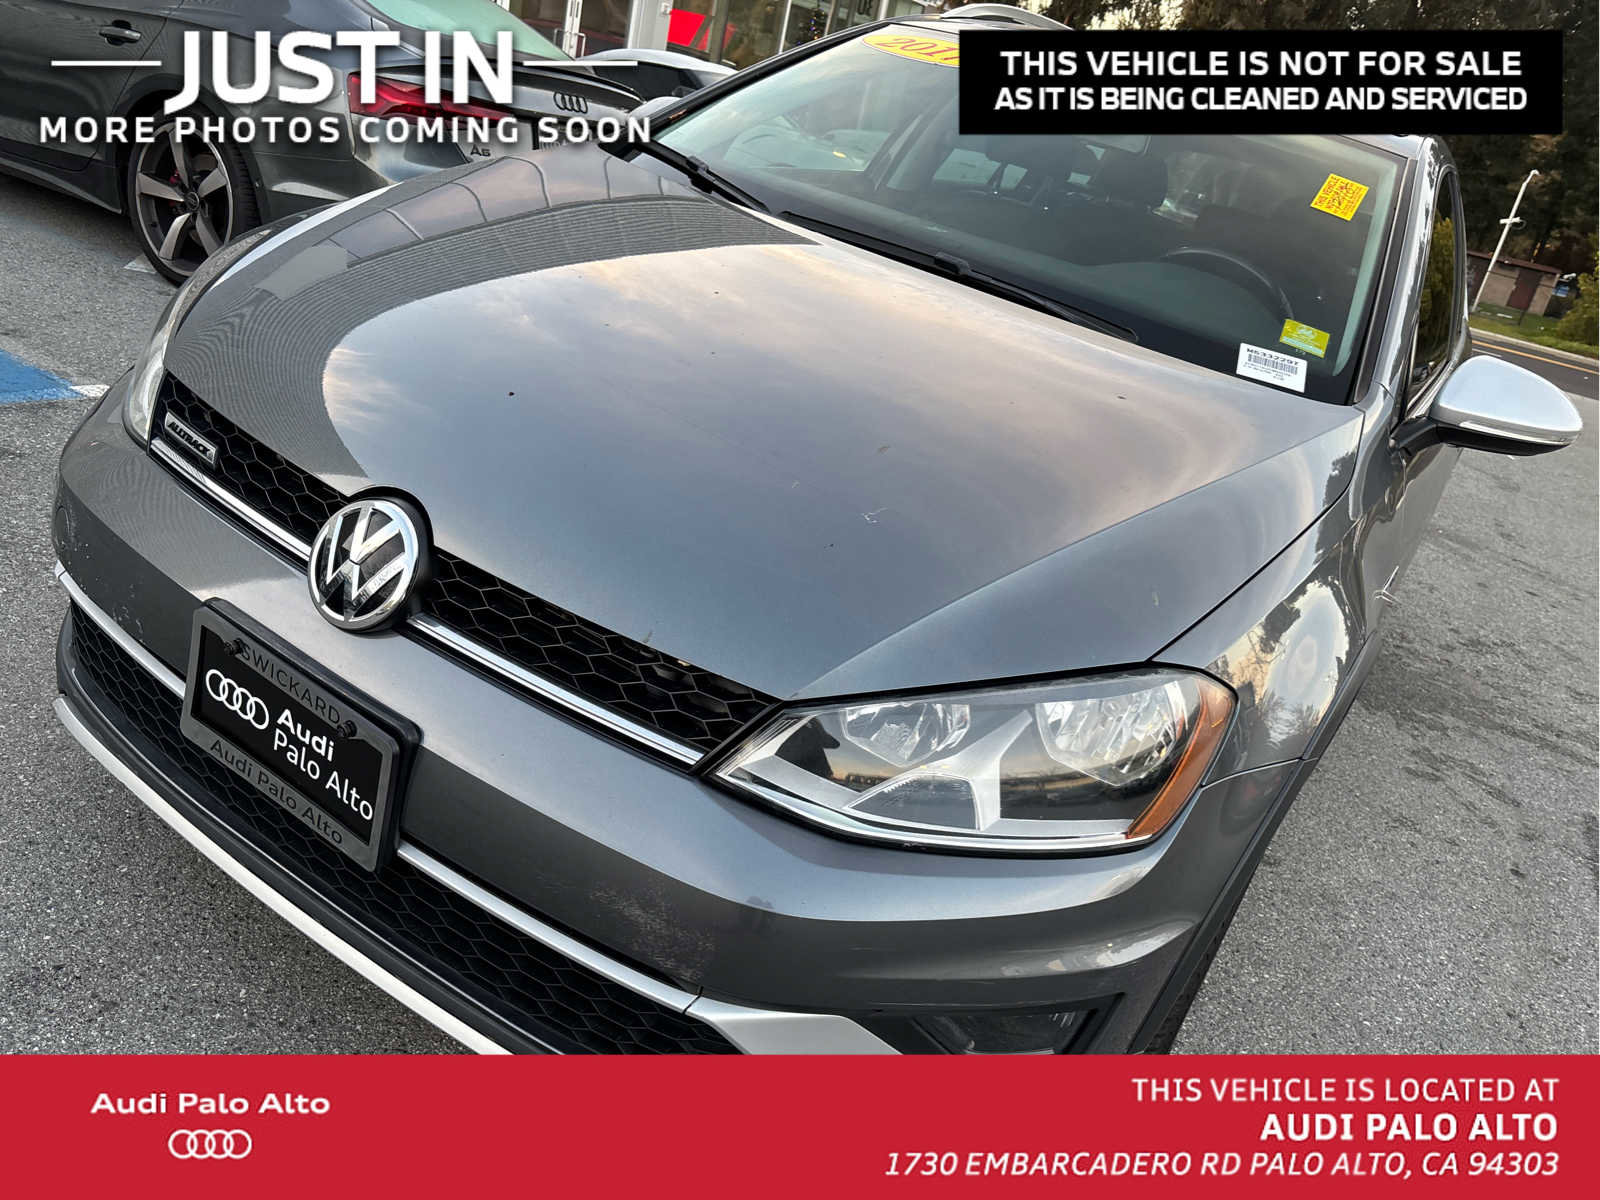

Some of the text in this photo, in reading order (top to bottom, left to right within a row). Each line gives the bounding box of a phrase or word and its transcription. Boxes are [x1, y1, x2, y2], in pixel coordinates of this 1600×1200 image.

[241, 642, 340, 725] SWICKARD
[210, 739, 343, 845] Audi Palo Alto
